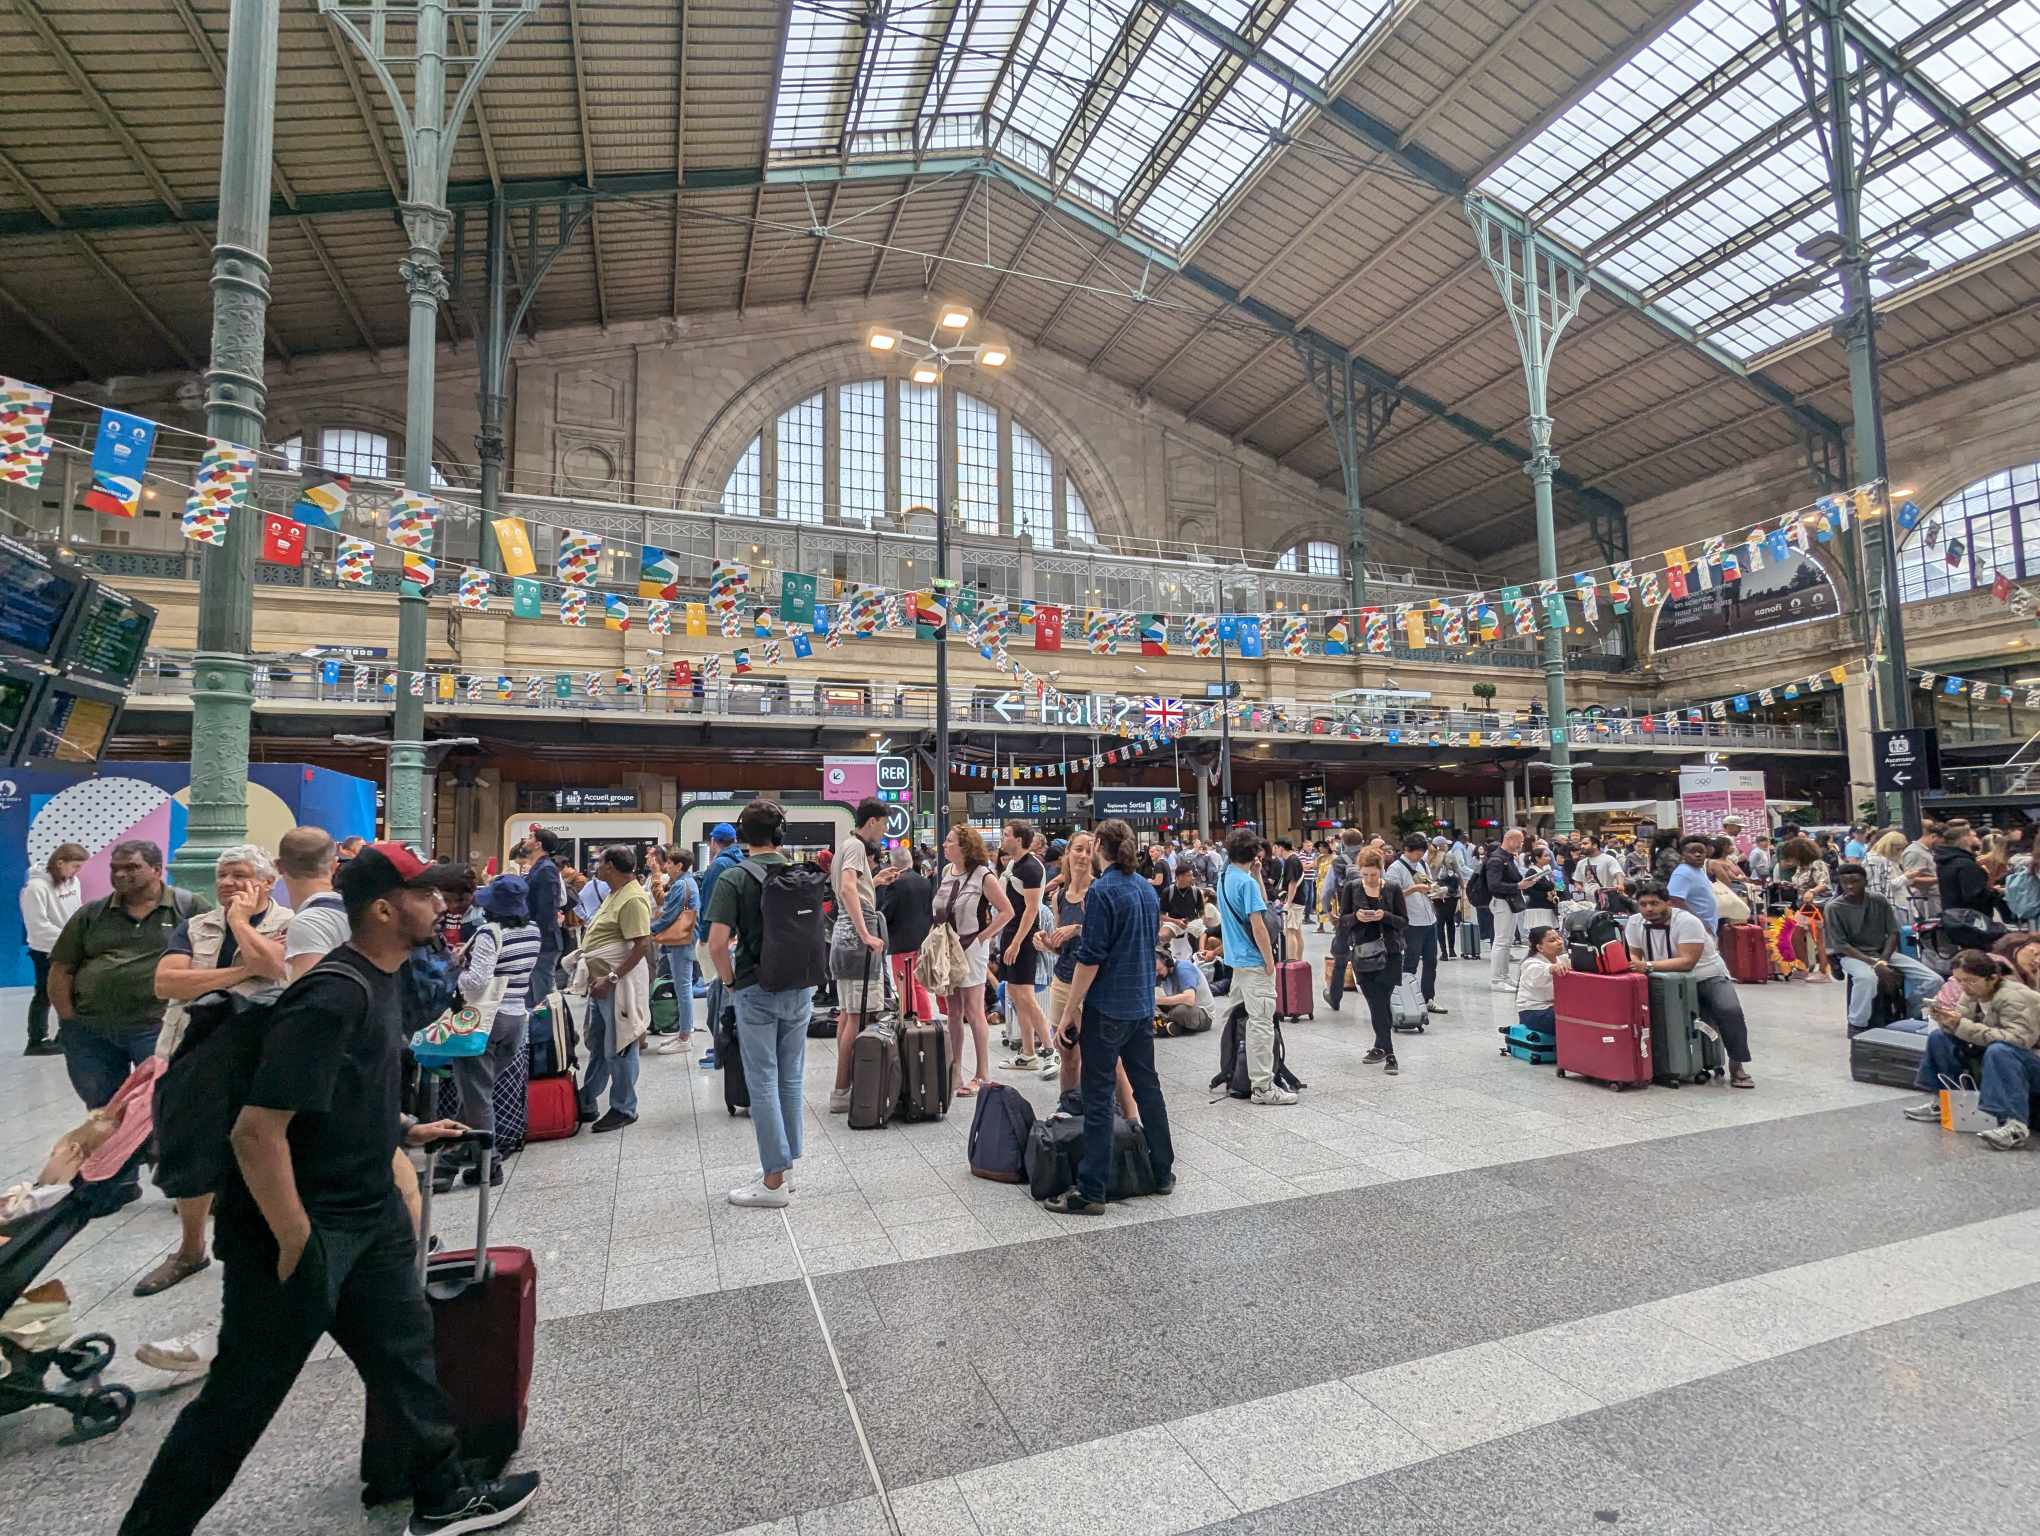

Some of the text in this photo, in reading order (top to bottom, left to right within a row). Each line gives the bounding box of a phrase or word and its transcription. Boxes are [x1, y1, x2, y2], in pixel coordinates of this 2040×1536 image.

[1754, 603, 1783, 616] sanofi
[1041, 693, 1130, 725] Hall 2
[881, 766, 905, 780] RER
[584, 793, 634, 803] Accueil groupe
[890, 791, 897, 799] D
[902, 791, 909, 799] E
[1129, 801, 1146, 809] Sortie
